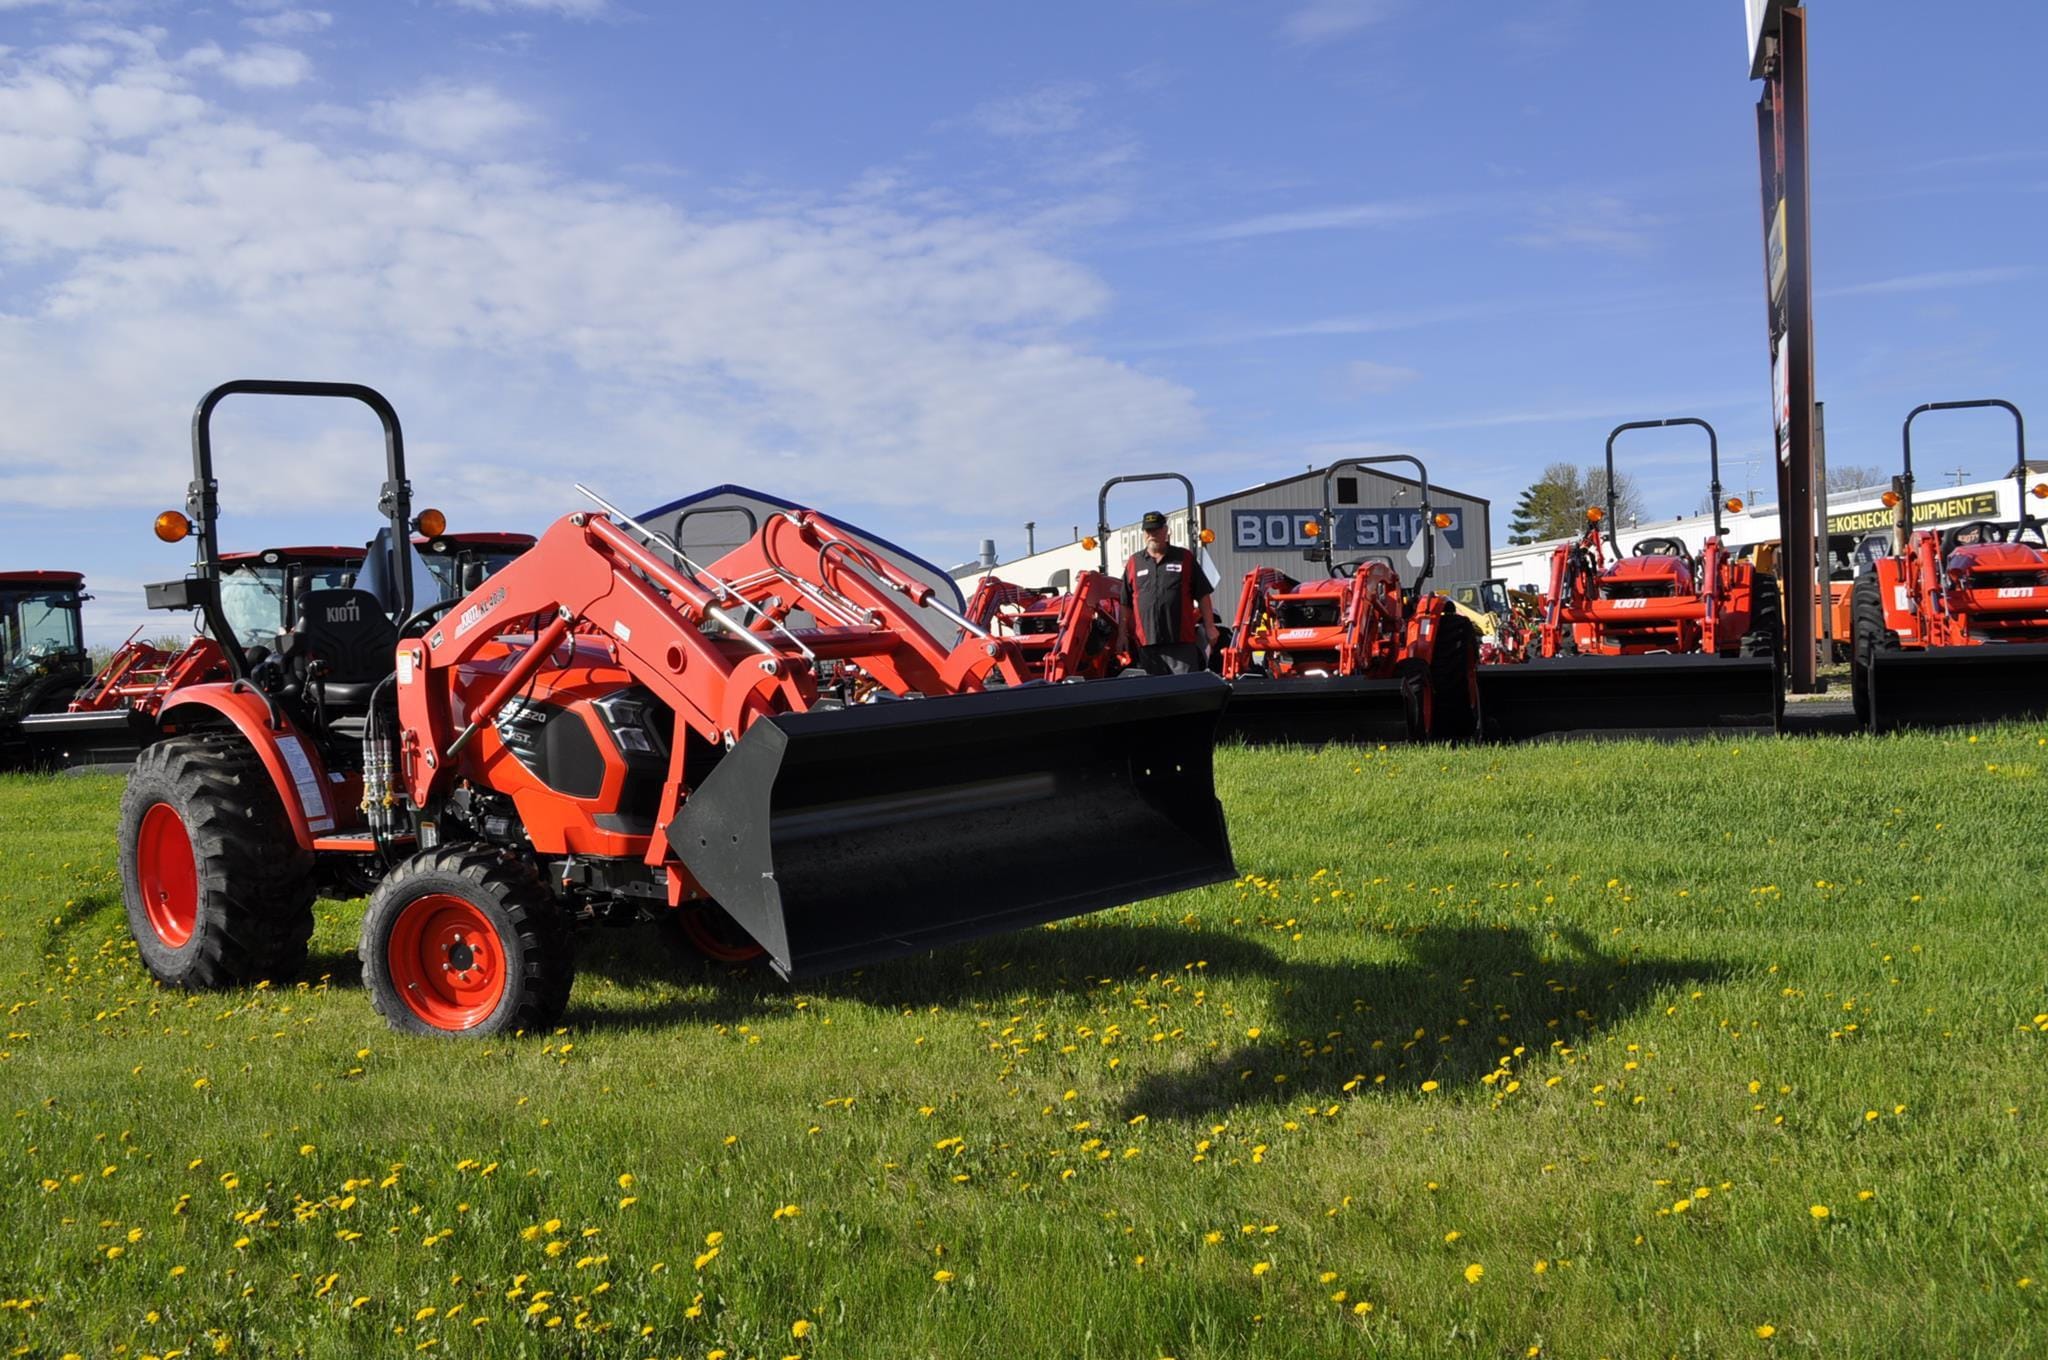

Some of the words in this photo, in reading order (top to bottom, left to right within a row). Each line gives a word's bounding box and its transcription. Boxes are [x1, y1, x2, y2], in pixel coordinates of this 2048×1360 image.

[1911, 497, 1974, 524] UIPMENT
[1612, 598, 1648, 609] KIOTI
[326, 605, 360, 623] KIOTI
